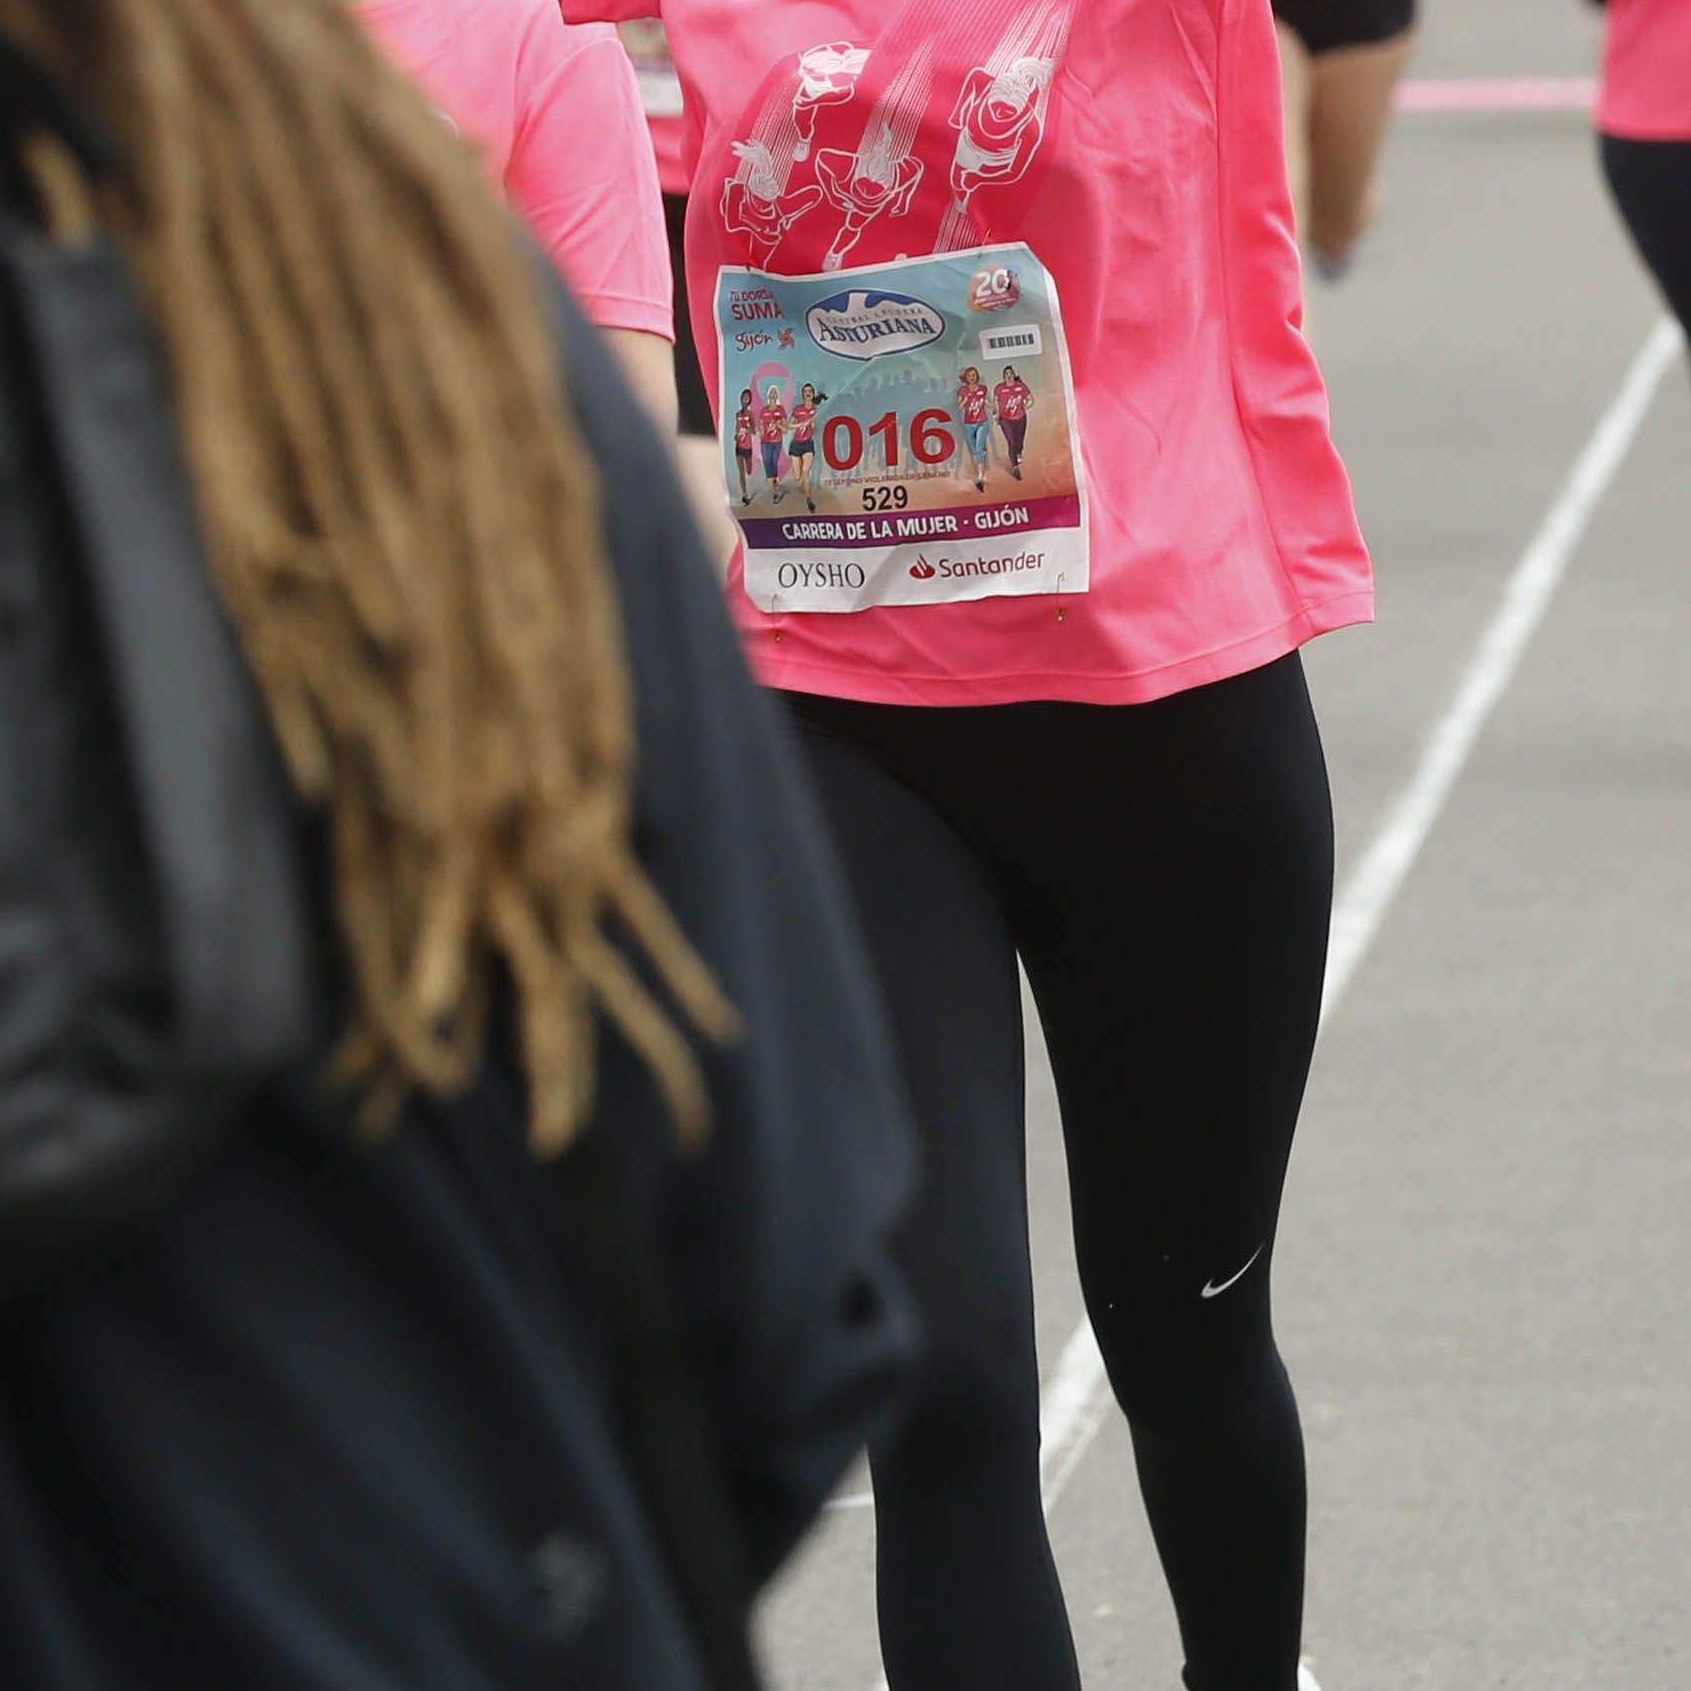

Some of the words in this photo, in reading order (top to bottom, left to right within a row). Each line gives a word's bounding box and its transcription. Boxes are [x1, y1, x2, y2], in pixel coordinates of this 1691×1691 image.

[976, 269, 1011, 297] 20
[731, 302, 785, 320] SUMA
[817, 317, 936, 343] ASTURIANA
[822, 408, 955, 471] 016
[862, 485, 908, 511] 529
[782, 522, 843, 541] CARRERA
[846, 521, 868, 540] DE
[871, 519, 892, 538] LA
[898, 515, 958, 537] MUJER
[975, 504, 1029, 529] GIJÓN
[778, 563, 864, 588] OYSHO
[940, 553, 1045, 578] Santander
